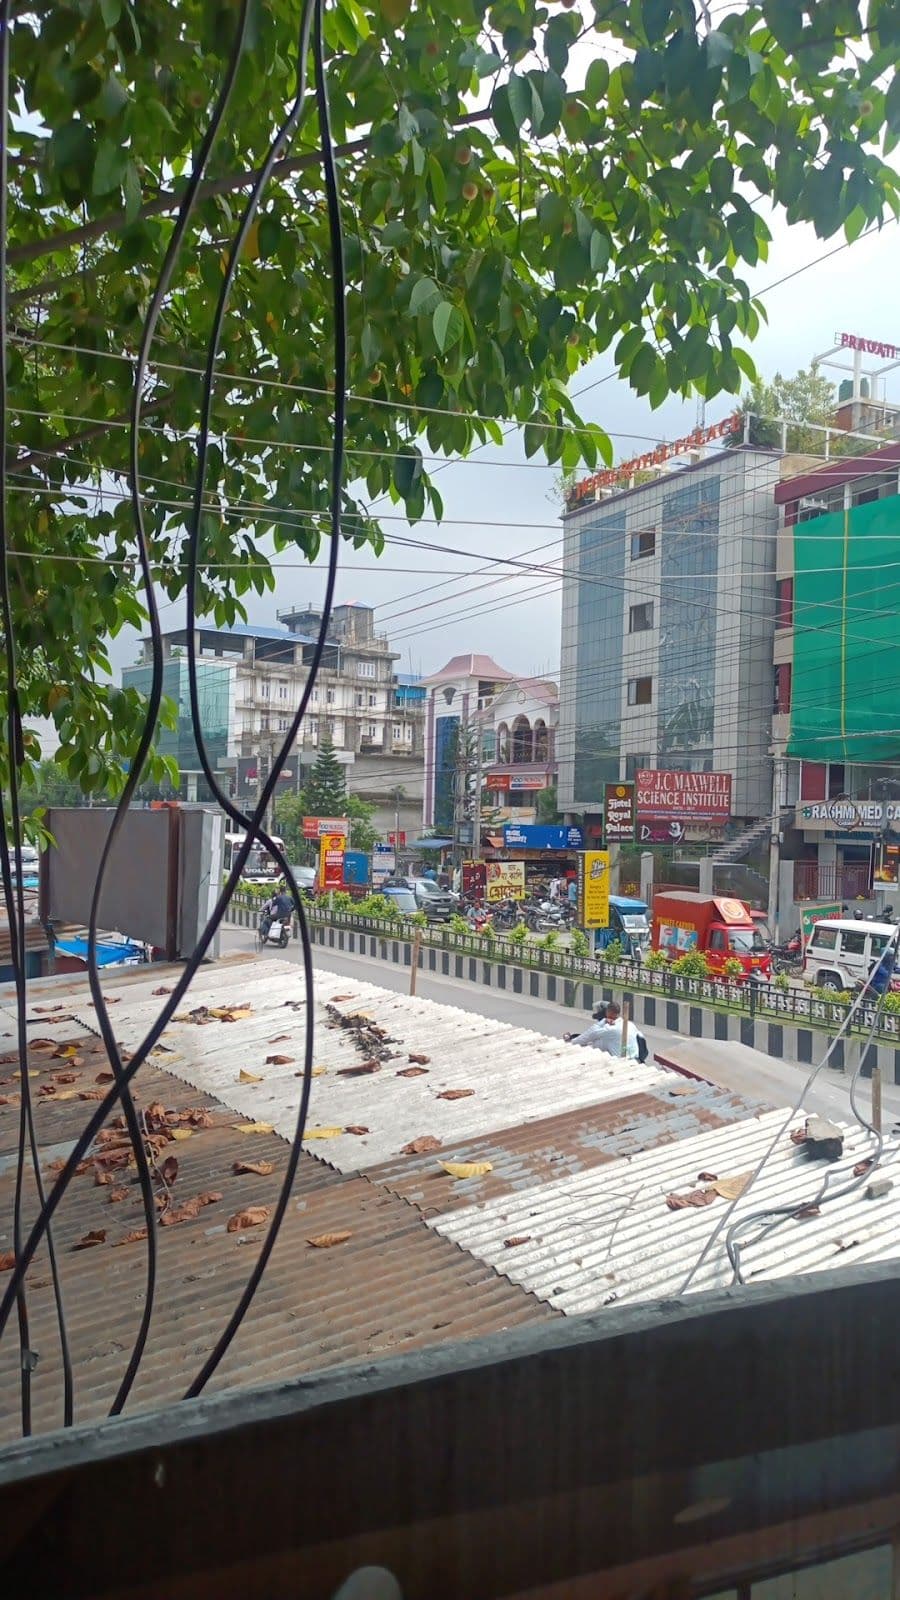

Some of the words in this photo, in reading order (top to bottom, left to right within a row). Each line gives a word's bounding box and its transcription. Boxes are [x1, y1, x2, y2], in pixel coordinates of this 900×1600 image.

[655, 772, 671, 791] J.C
[674, 774, 729, 793] MAXWELL
[608, 798, 631, 810] Hotel
[637, 790, 679, 806] SCIENCE
[682, 793, 729, 807] INSTITUTE
[607, 810, 631, 823] Royal
[858, 805, 882, 820] MED
[605, 823, 634, 834] Palace
